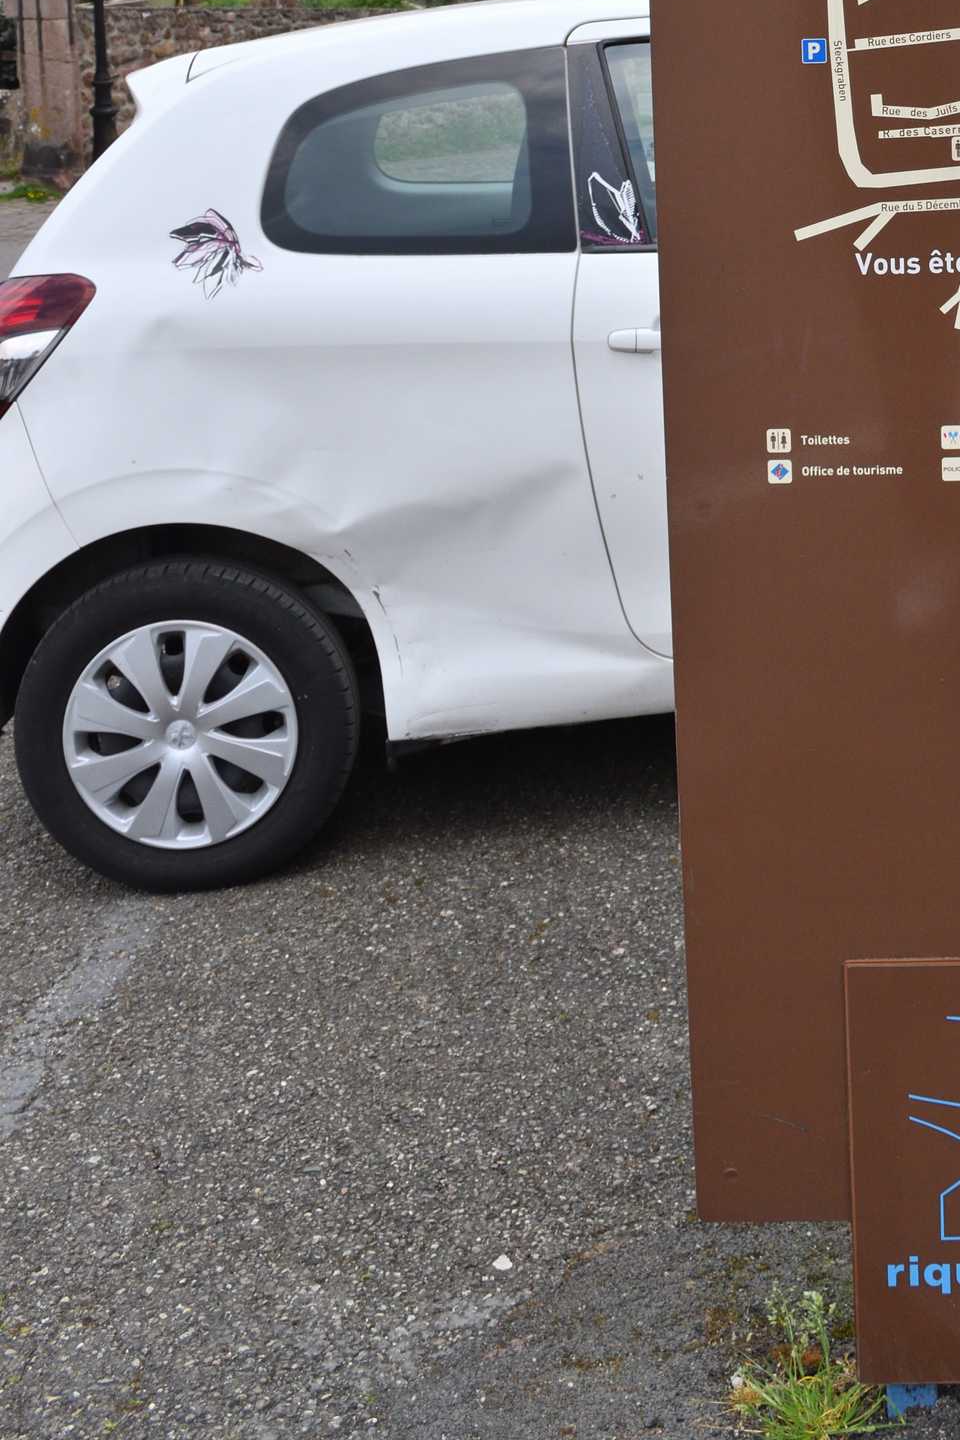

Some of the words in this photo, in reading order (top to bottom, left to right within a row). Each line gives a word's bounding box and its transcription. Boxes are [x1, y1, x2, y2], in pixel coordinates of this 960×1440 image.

[868, 37, 886, 47] Rue
[890, 35, 906, 45] des
[909, 31, 951, 43] Cordiers
[834, 41, 846, 101] Steckgraben
[882, 107, 900, 116] Rue
[910, 109, 927, 118] des
[936, 104, 957, 116] Juifs
[900, 128, 919, 137] des
[881, 203, 900, 212] Rue
[903, 202, 914, 211] du
[918, 201, 923, 209] 5
[855, 252, 921, 275] Vous
[801, 435, 850, 446] Toilettes
[802, 466, 836, 476] Office
[838, 466, 850, 476] de
[853, 465, 903, 475] tourisme
